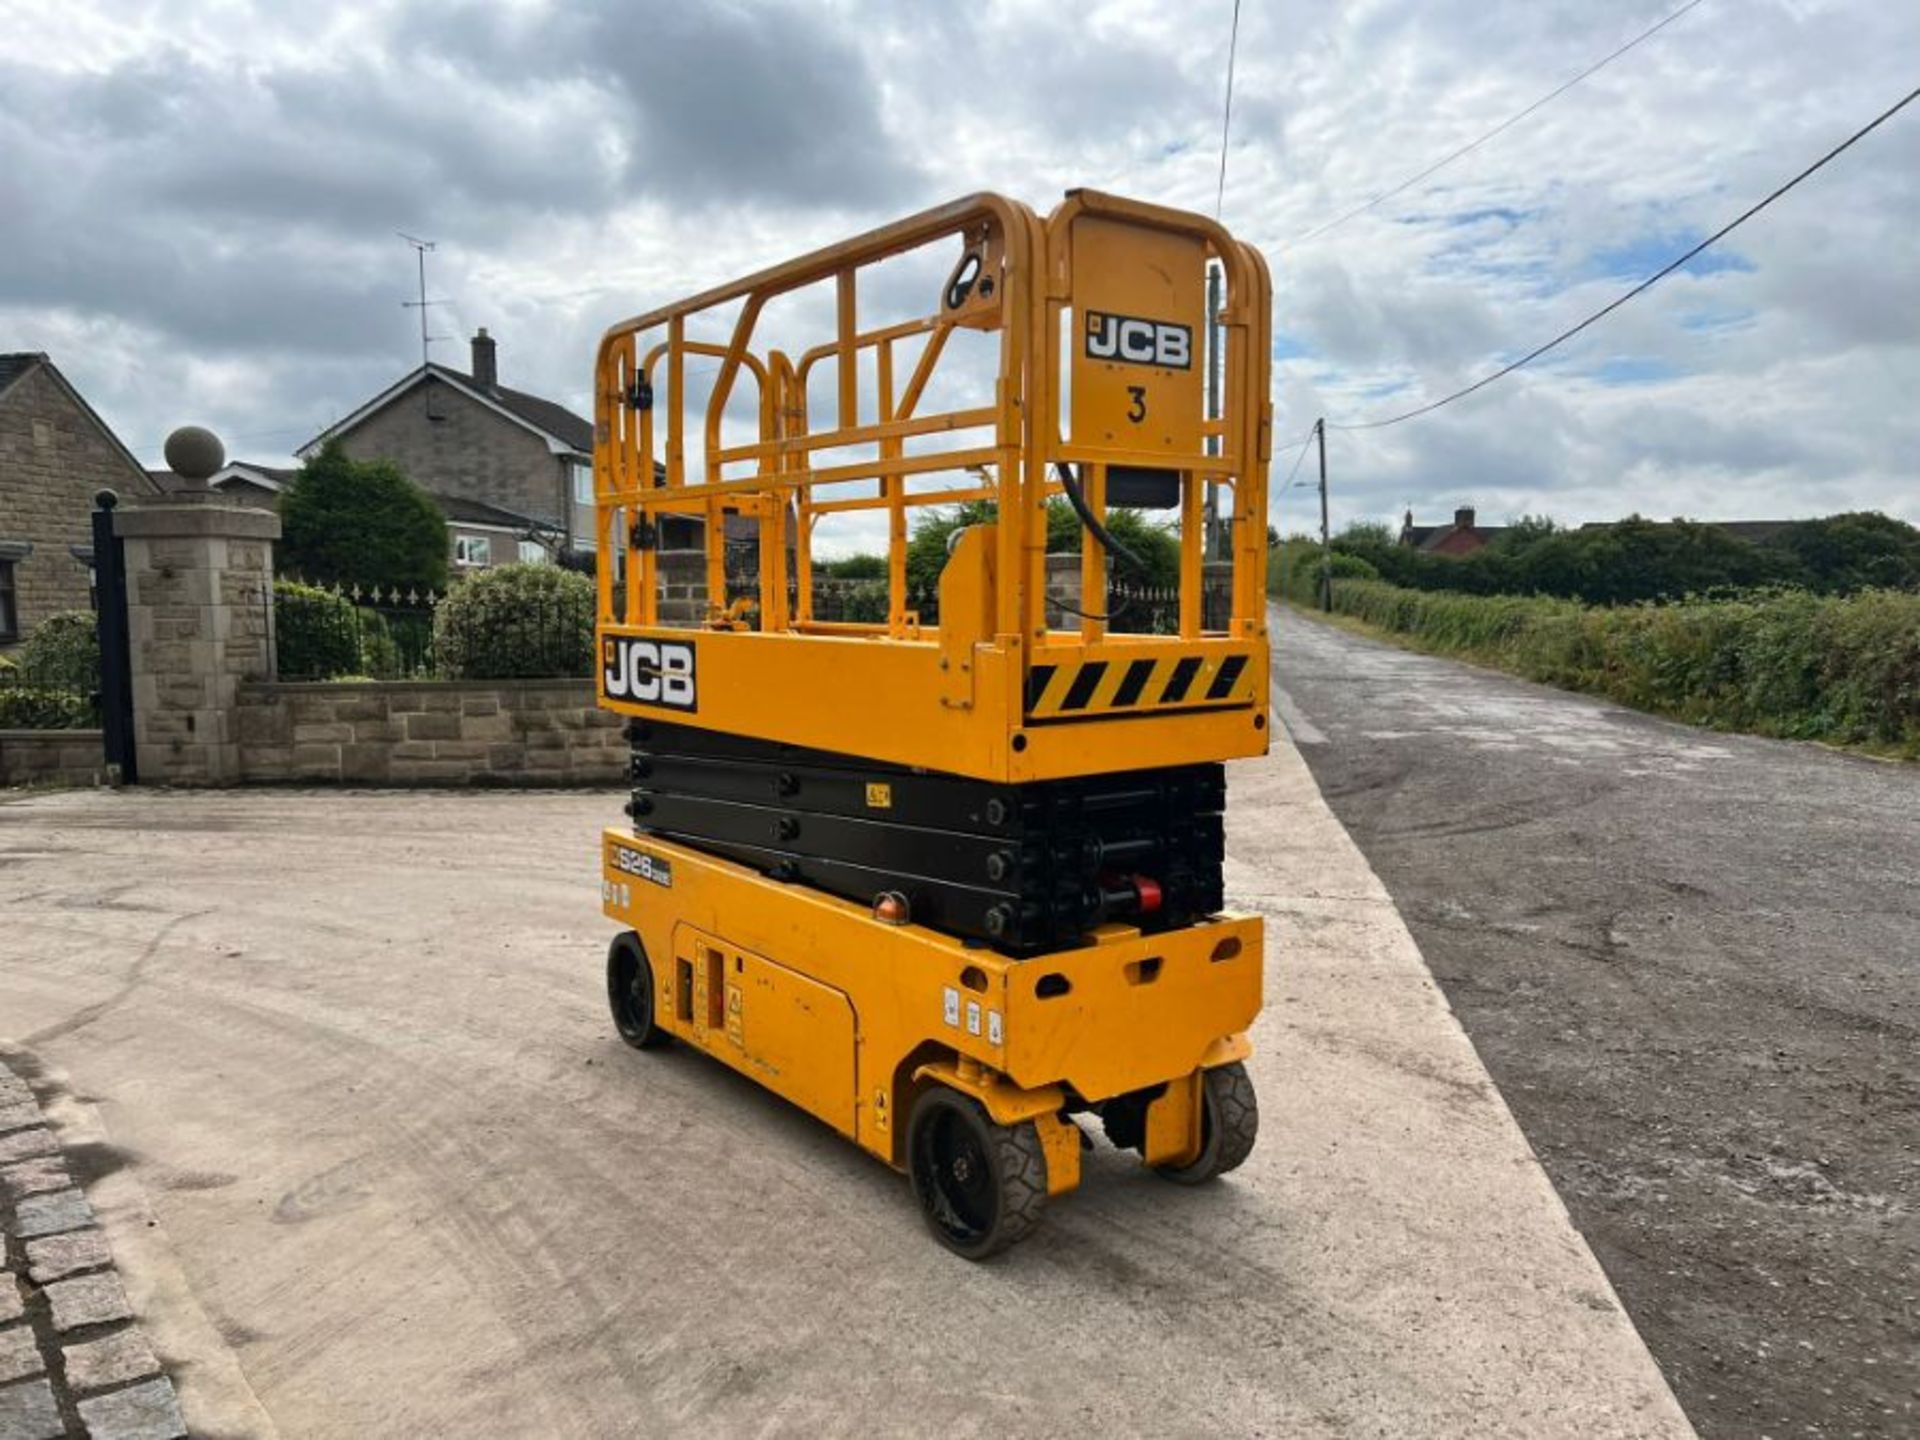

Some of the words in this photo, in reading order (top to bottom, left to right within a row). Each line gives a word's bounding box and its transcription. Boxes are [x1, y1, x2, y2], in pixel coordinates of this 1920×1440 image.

[1088, 316, 1189, 366] JCB
[1127, 385, 1146, 423] 3
[605, 641, 694, 705] JCB
